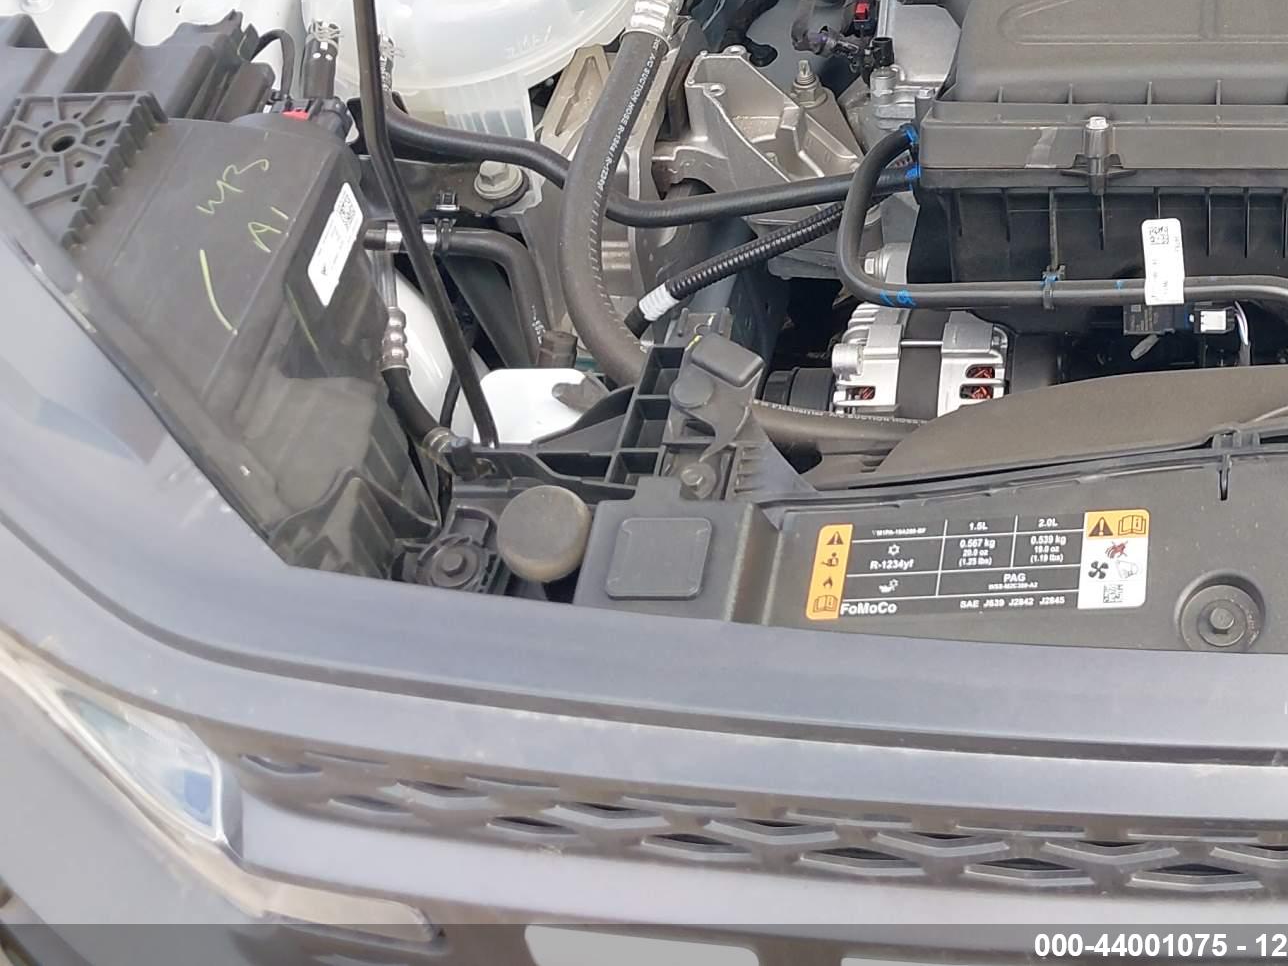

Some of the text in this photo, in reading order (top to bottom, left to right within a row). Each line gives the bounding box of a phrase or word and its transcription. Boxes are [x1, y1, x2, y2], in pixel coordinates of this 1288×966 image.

[633, 67, 651, 104] SUCTION
[619, 102, 636, 127] HOSE
[968, 521, 989, 532] 1.5L
[1038, 518, 1059, 528] 2.0L
[959, 537, 996, 549] 0.567 kg
[1030, 534, 1067, 546] 0.539 kg
[869, 559, 915, 570] R-1234yf
[1003, 573, 1027, 583] PAG
[959, 599, 980, 609] SAE
[1008, 596, 1034, 607] J2842
[1039, 595, 1066, 606] J2845
[839, 601, 898, 617] FoMoCo
